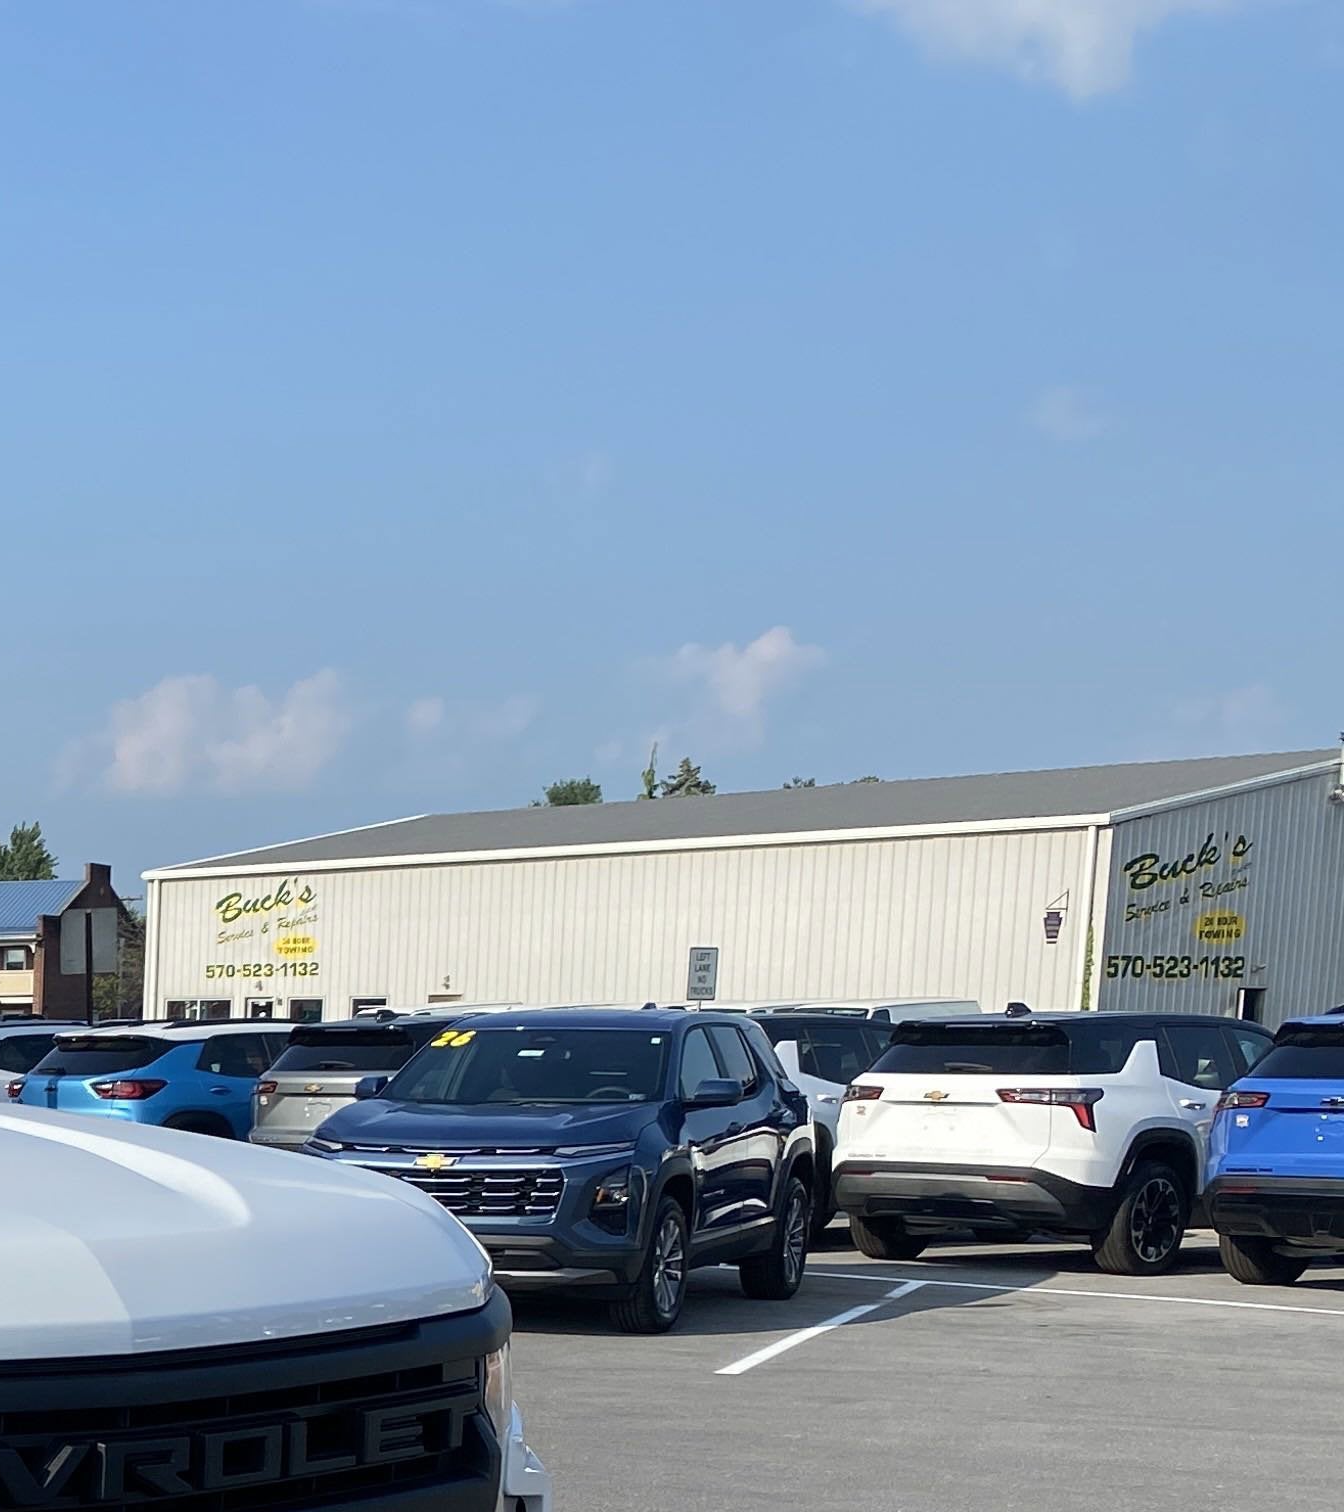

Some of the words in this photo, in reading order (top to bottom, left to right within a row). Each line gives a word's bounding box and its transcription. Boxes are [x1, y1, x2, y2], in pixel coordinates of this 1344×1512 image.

[1123, 831, 1253, 889] Buck's
[215, 877, 318, 923] Buck's
[1199, 929, 1241, 940] TOWING
[205, 962, 319, 979] 570-523-1132
[1106, 955, 1245, 979] 570-523-1132
[430, 1030, 477, 1047] 26
